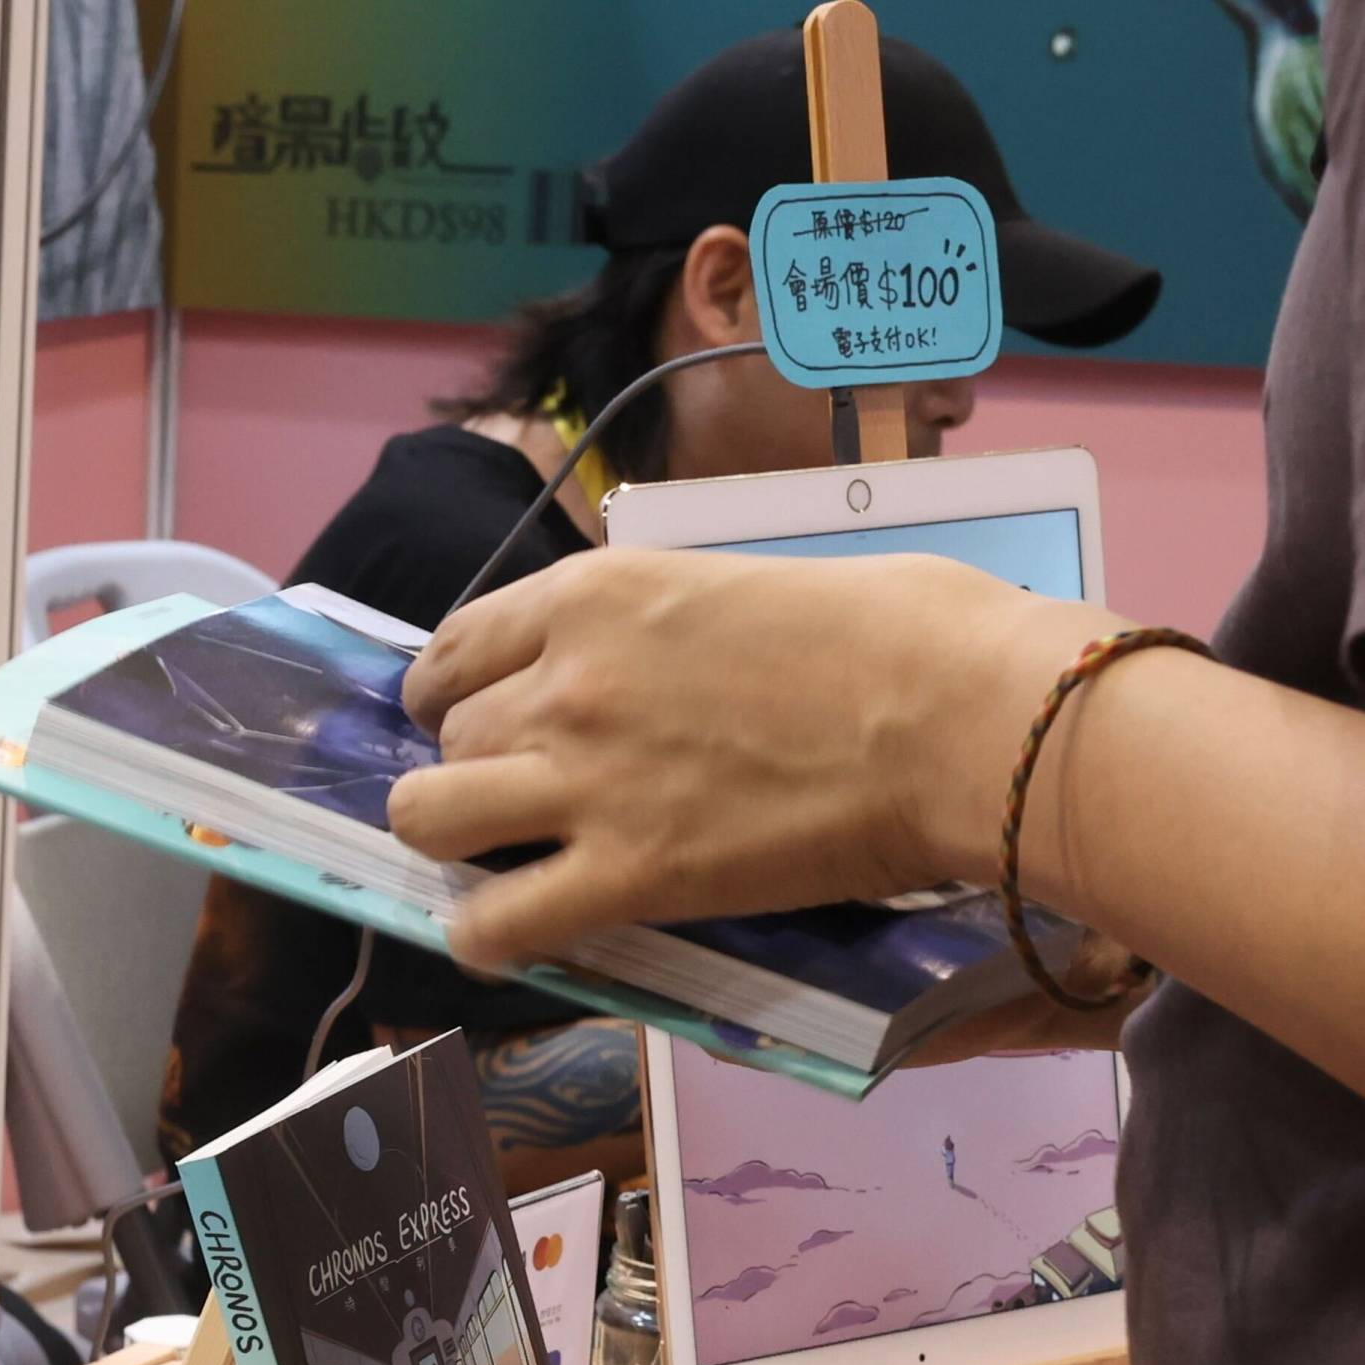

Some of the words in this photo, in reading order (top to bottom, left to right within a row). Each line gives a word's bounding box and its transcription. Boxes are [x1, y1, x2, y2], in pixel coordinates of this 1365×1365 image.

[199, 1209, 264, 1355] CHRONOS
[308, 1231, 389, 1297] CHRONOS
[397, 1186, 471, 1251] EXPRESS
